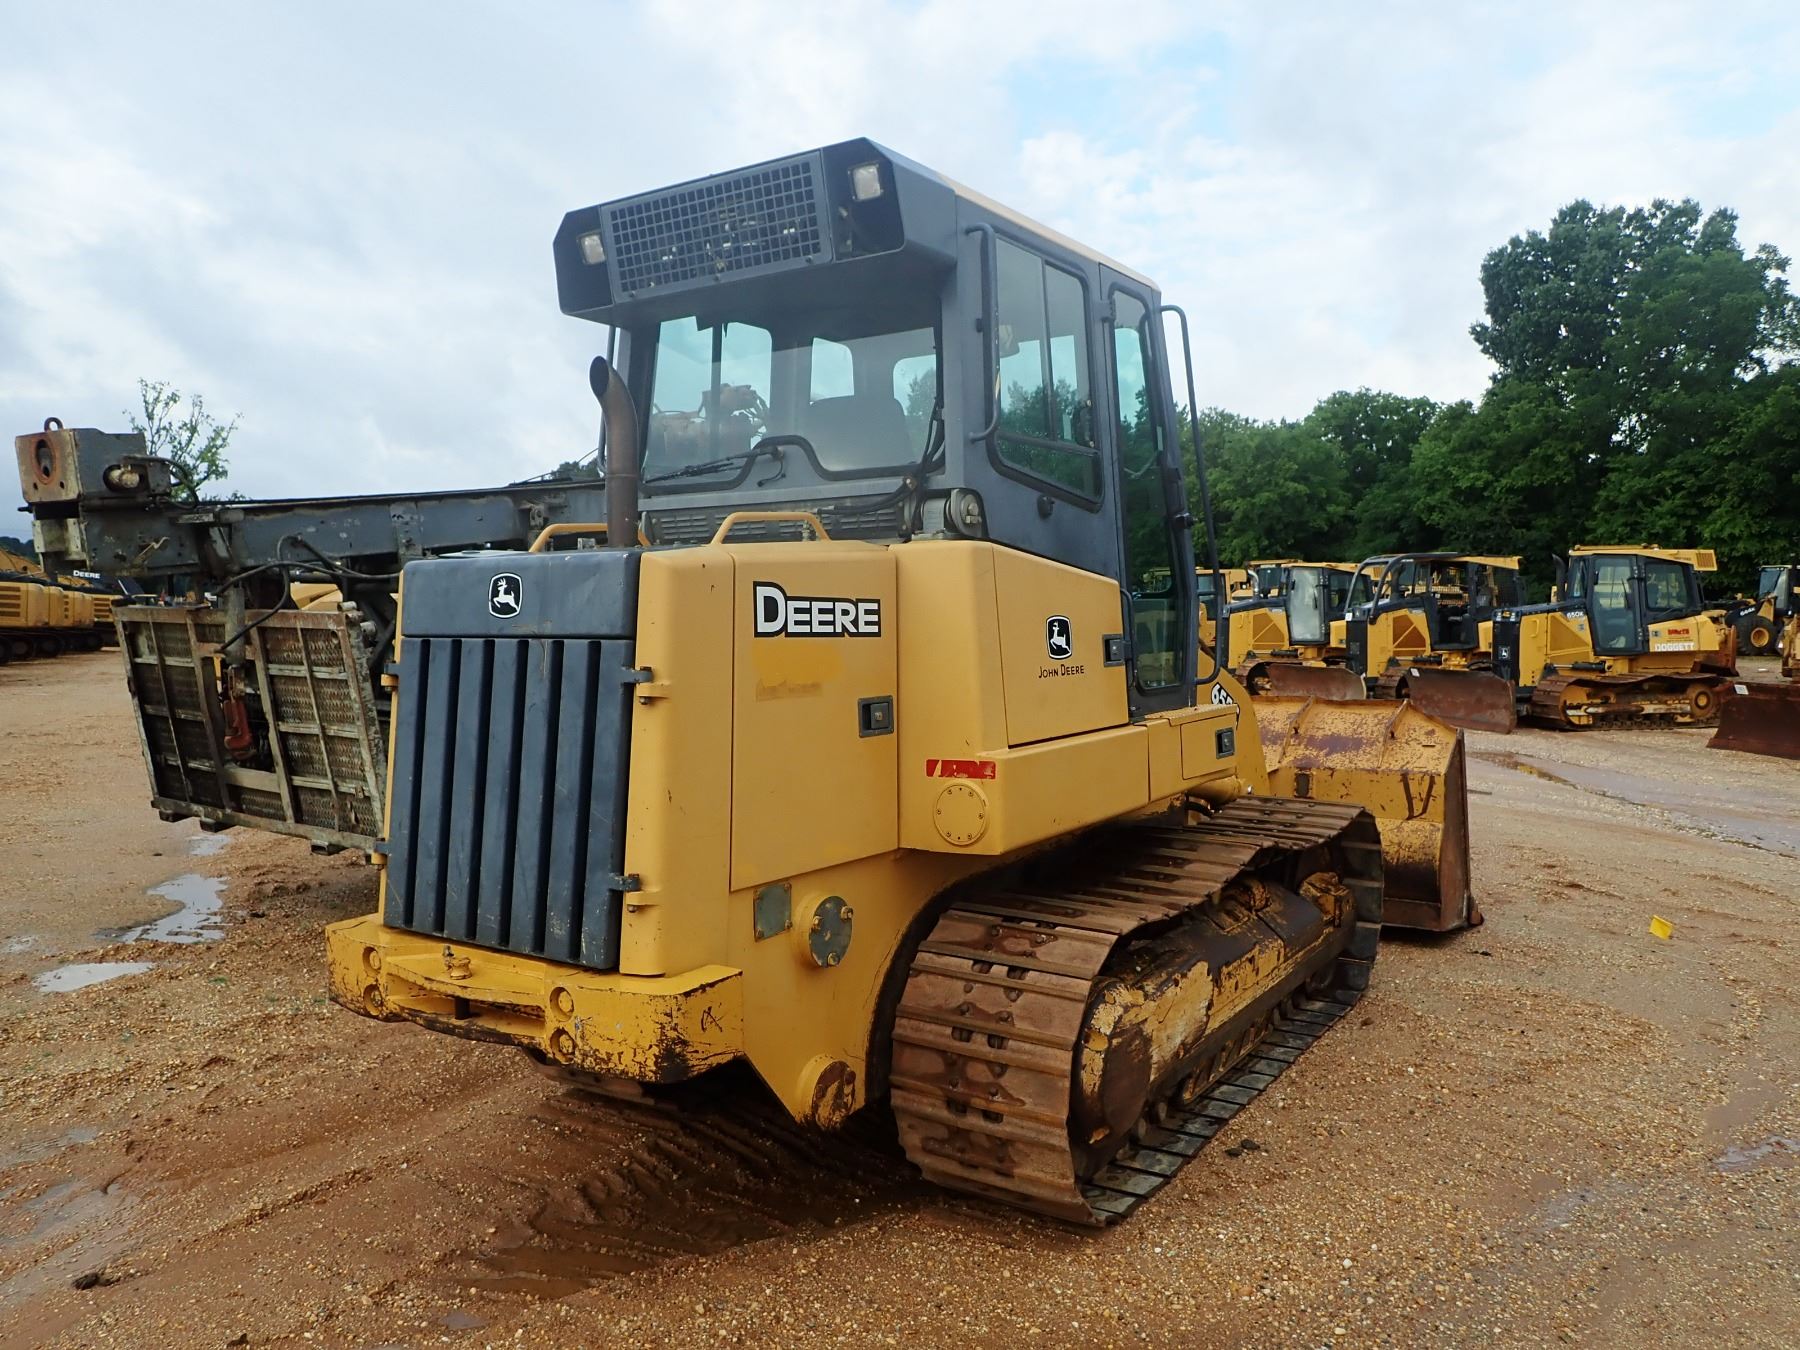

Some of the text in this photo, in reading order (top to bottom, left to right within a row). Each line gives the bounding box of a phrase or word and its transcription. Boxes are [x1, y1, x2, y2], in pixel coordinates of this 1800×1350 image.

[73, 570, 101, 579] DEERE
[754, 583, 880, 635] DEERE
[1039, 664, 1084, 678] JOHN DEERE
